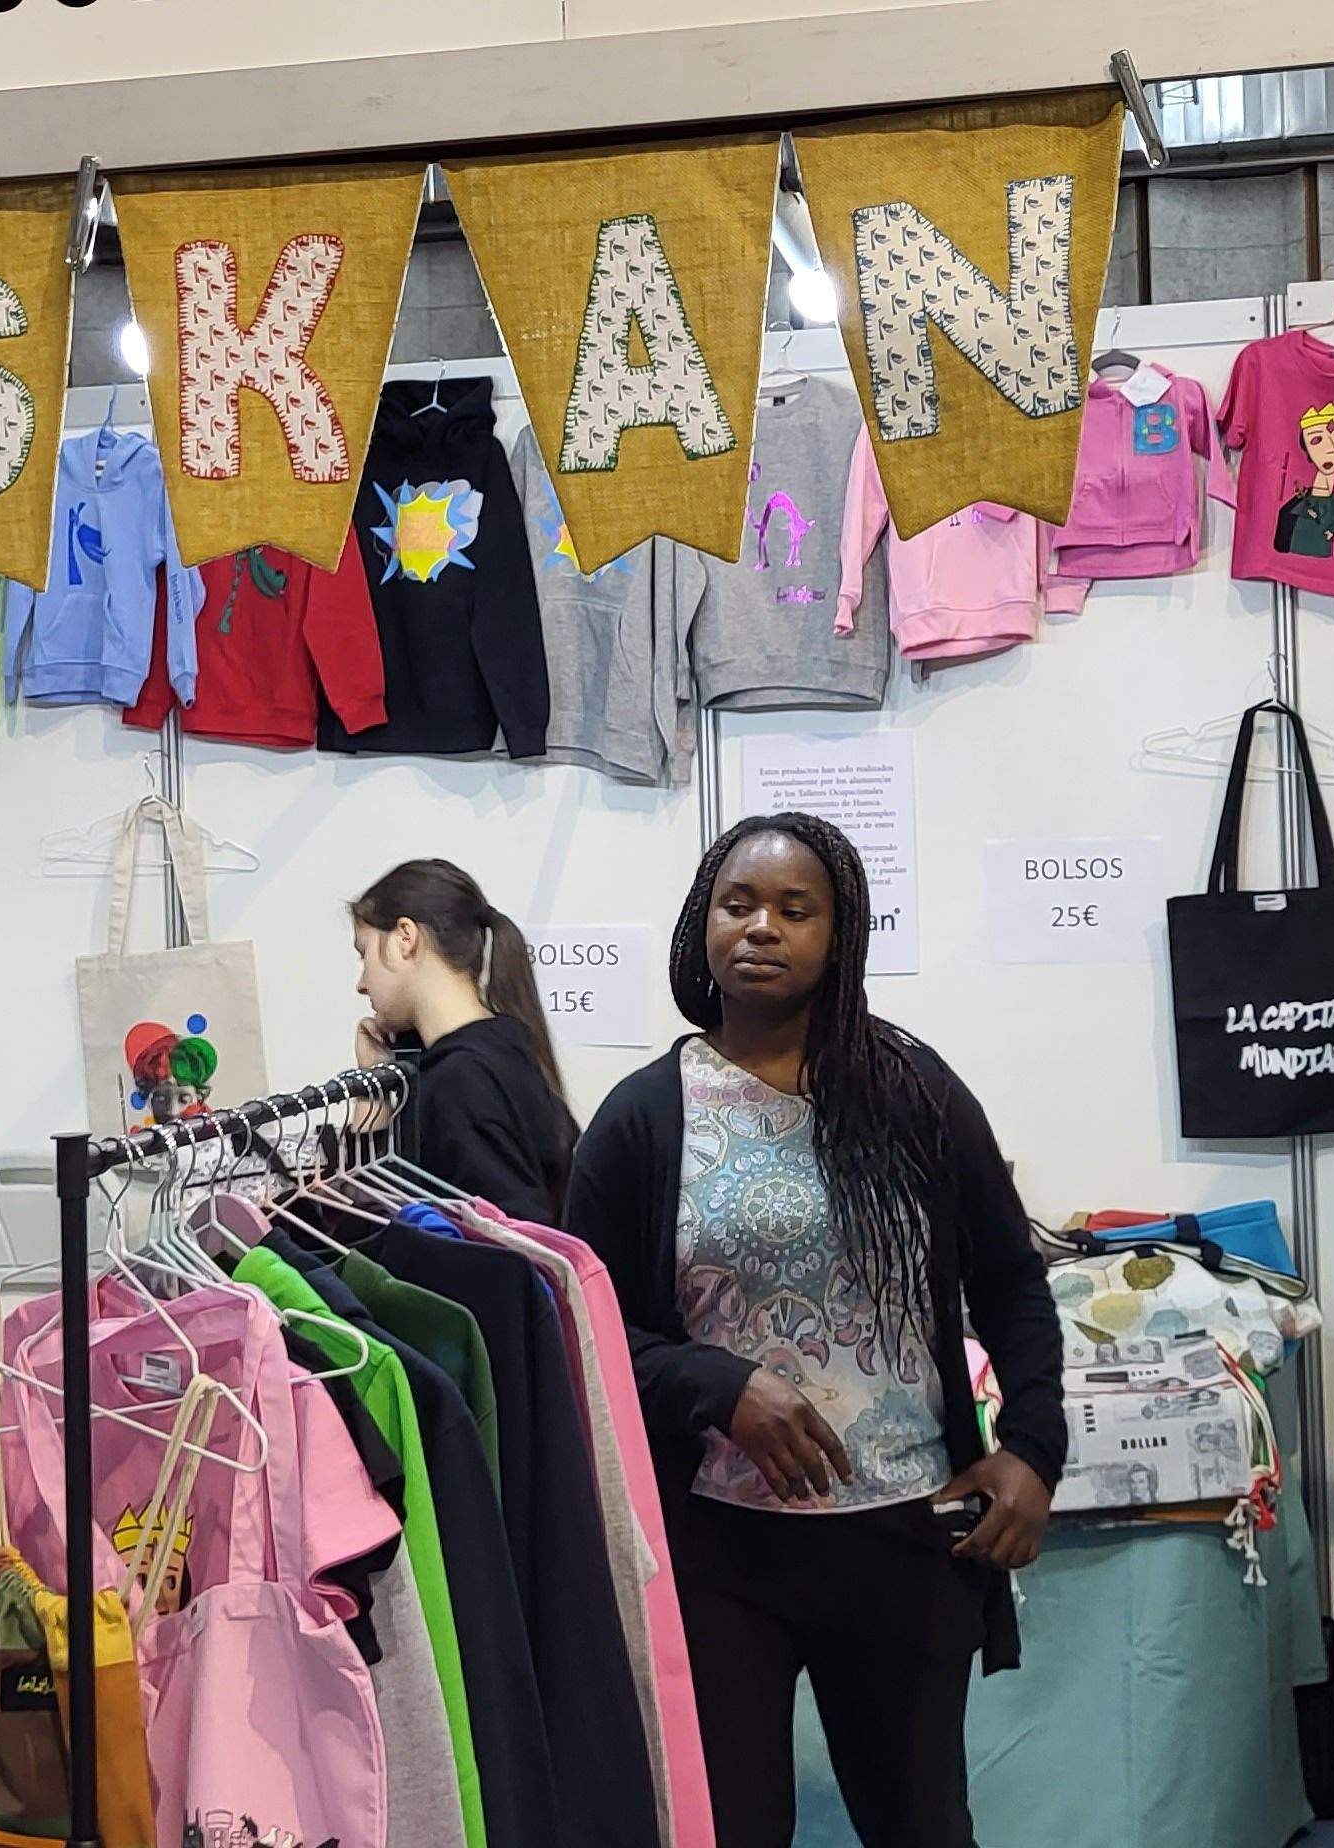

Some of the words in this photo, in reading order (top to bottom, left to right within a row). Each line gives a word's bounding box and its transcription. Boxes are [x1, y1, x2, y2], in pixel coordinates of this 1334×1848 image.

[1133, 404, 1180, 455] B
[1024, 856, 1123, 882] BOLSOS
[1050, 904, 1099, 929] 25€
[549, 990, 595, 1013] 15€
[1226, 1003, 1258, 1033] LA
